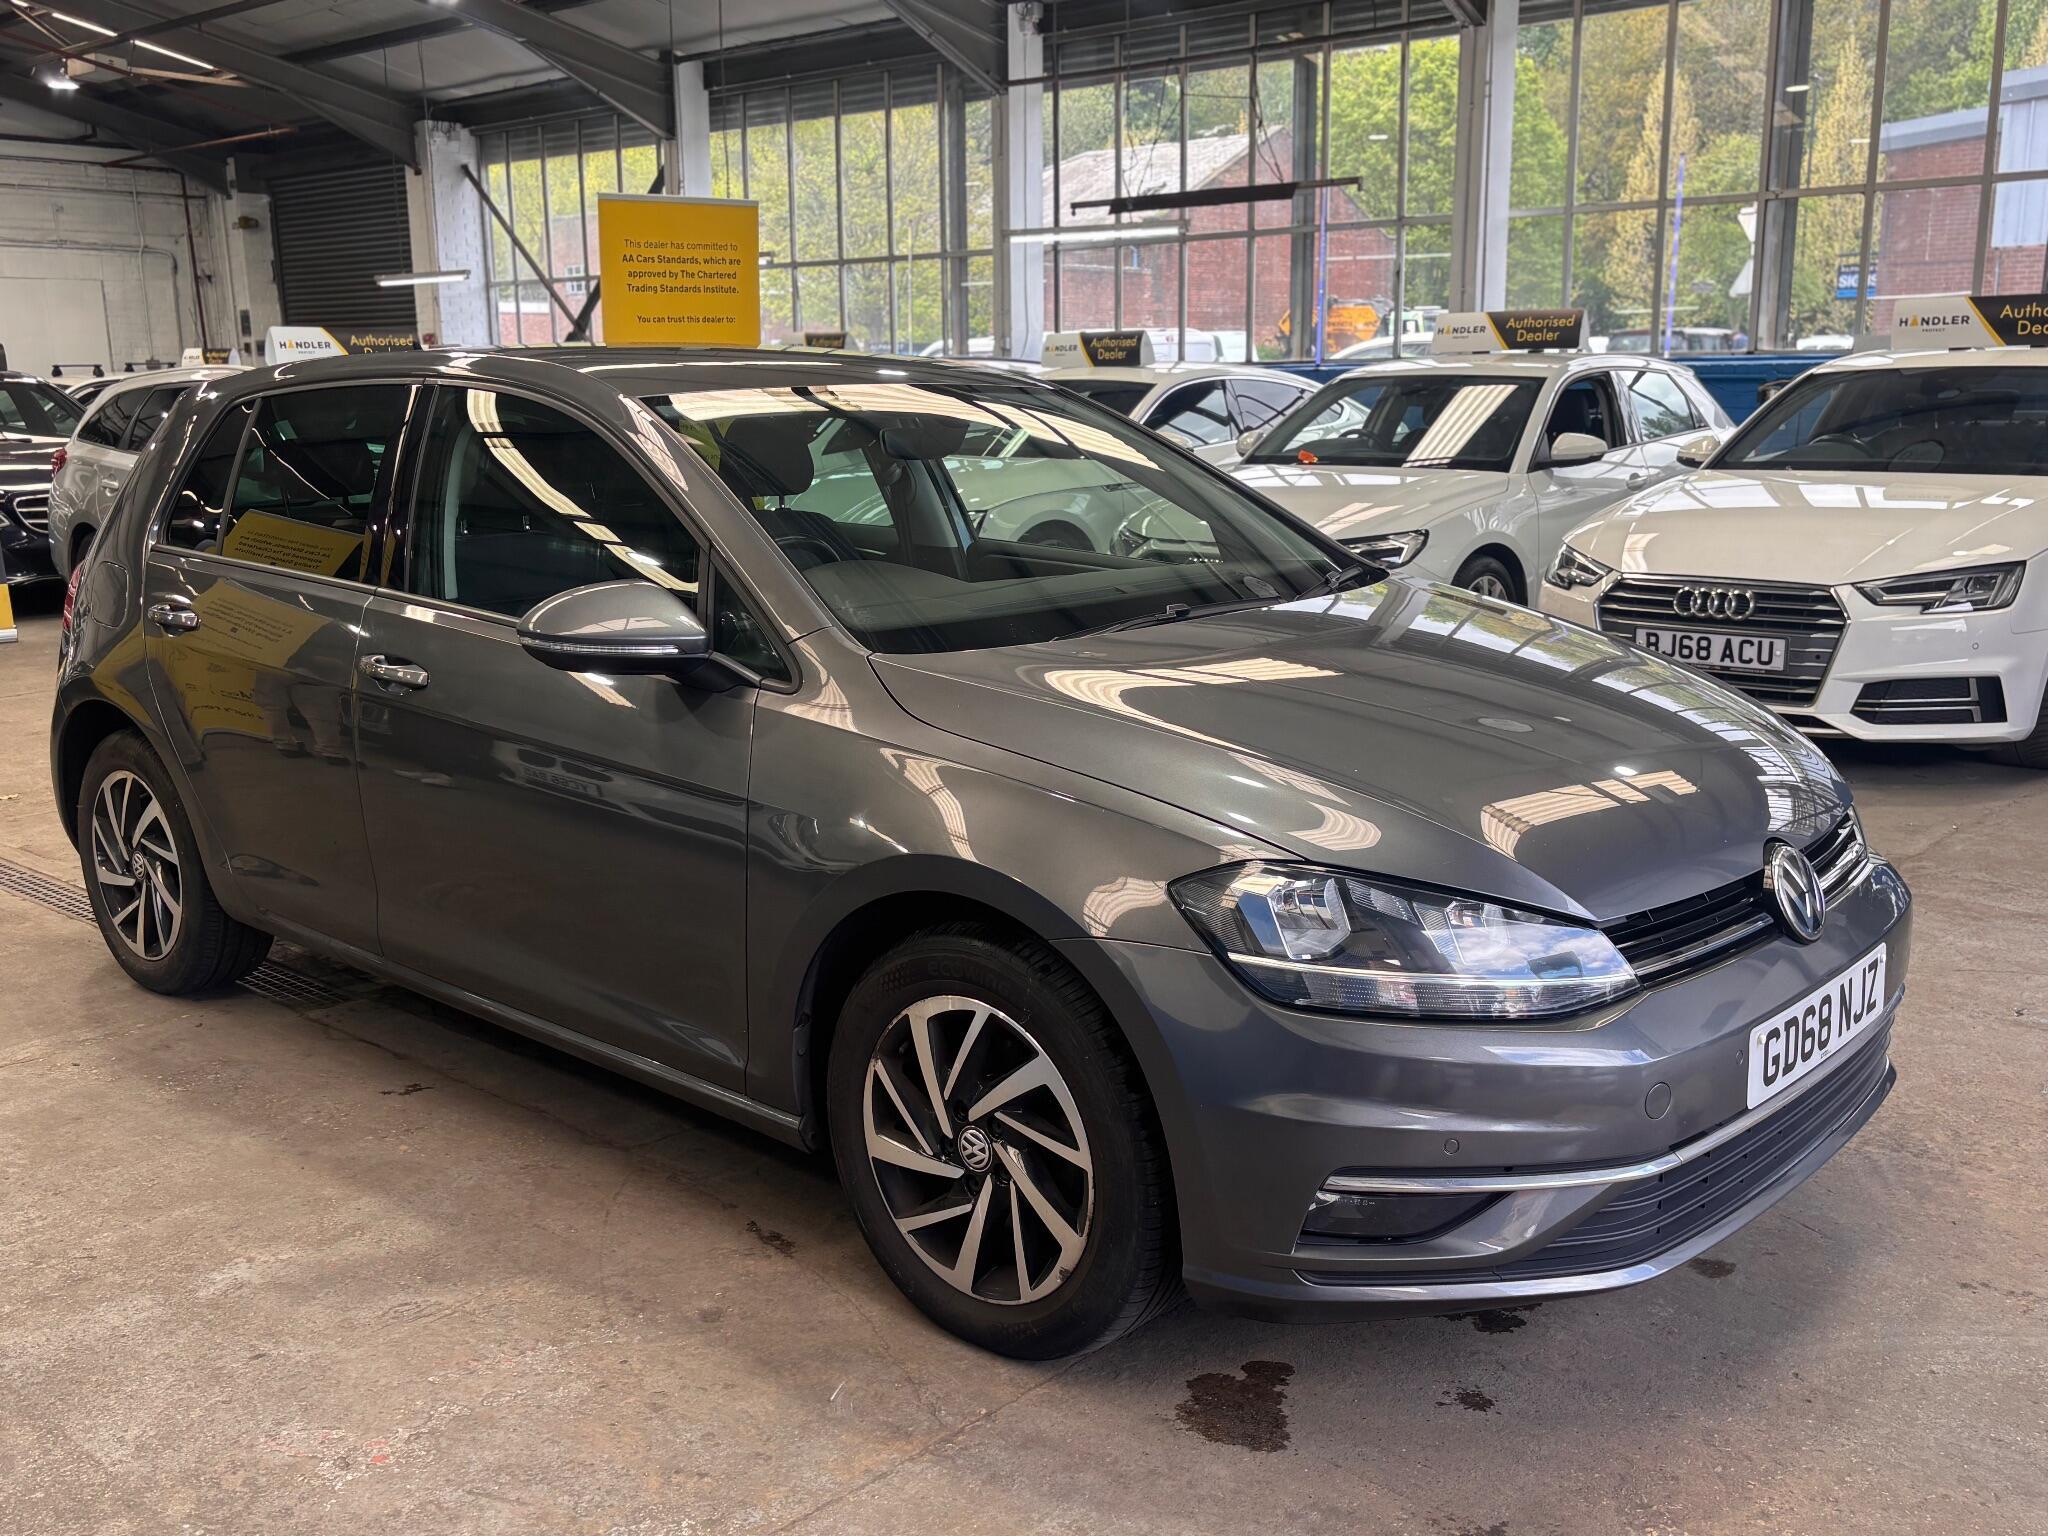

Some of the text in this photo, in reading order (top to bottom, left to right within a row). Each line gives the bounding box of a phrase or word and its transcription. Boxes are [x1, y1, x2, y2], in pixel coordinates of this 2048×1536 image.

[624, 239, 738, 251] This dealer has committed to
[622, 254, 741, 266] AA Cars Standards, which are
[627, 269, 737, 280] approved by The Chartered
[627, 284, 740, 294] Trading Standards Institute.
[637, 315, 651, 323] You
[667, 315, 685, 323] trust
[686, 315, 701, 323] this
[702, 315, 724, 323] dealer
[1506, 315, 1576, 329] Authorised
[350, 334, 413, 346] Authorised
[1090, 335, 1138, 348] Authorised
[1516, 330, 1560, 342] Dealer
[1097, 349, 1127, 360] Dealer
[1719, 637, 1774, 666] ACU
[1762, 957, 1879, 1088] GD68 NJZ
